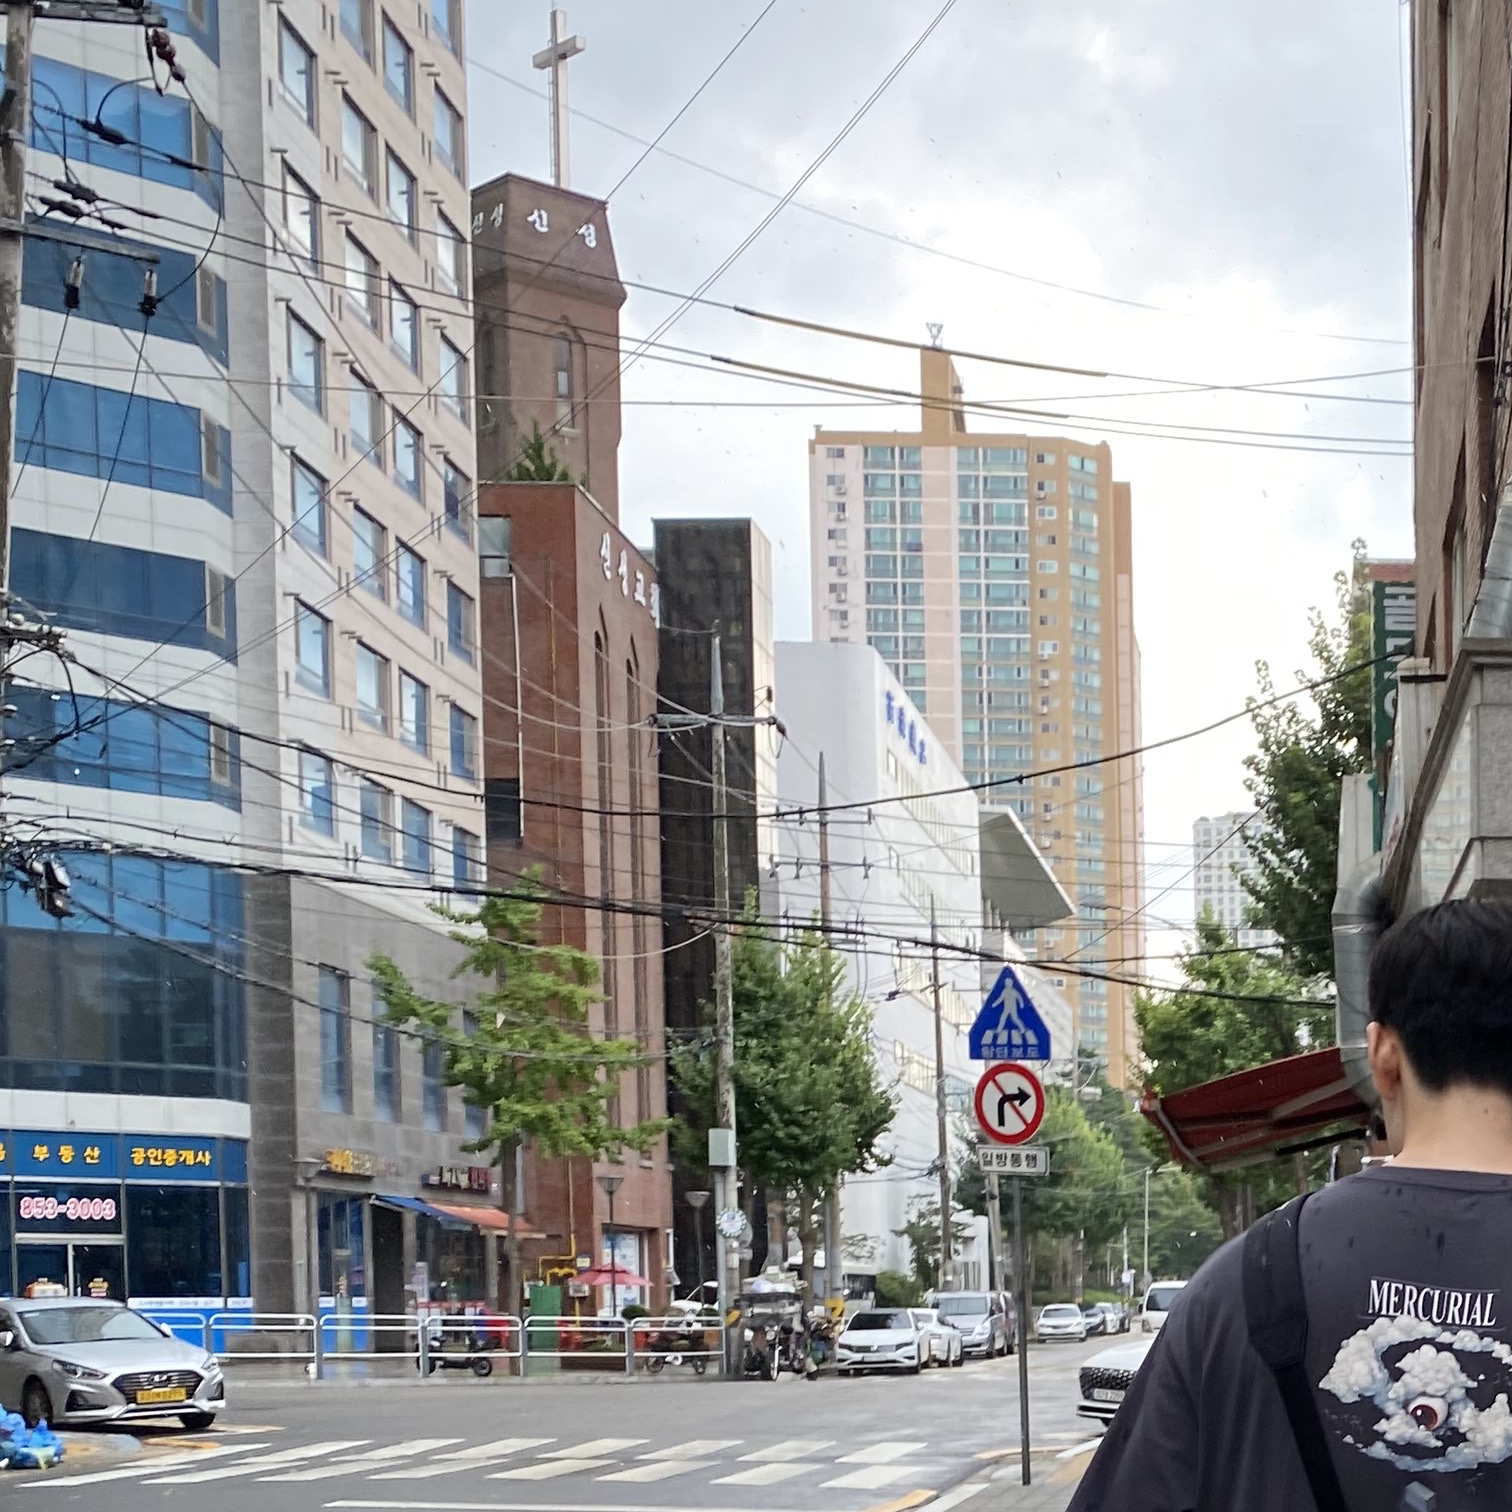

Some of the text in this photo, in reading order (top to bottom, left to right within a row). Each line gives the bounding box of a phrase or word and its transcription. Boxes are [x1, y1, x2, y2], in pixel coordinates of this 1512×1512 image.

[600, 532, 661, 629] 신성교회
[130, 1147, 212, 1167] 공인중개사
[982, 1152, 1037, 1168] 일방통행
[1368, 1279, 1497, 1326] MERCURIAL
